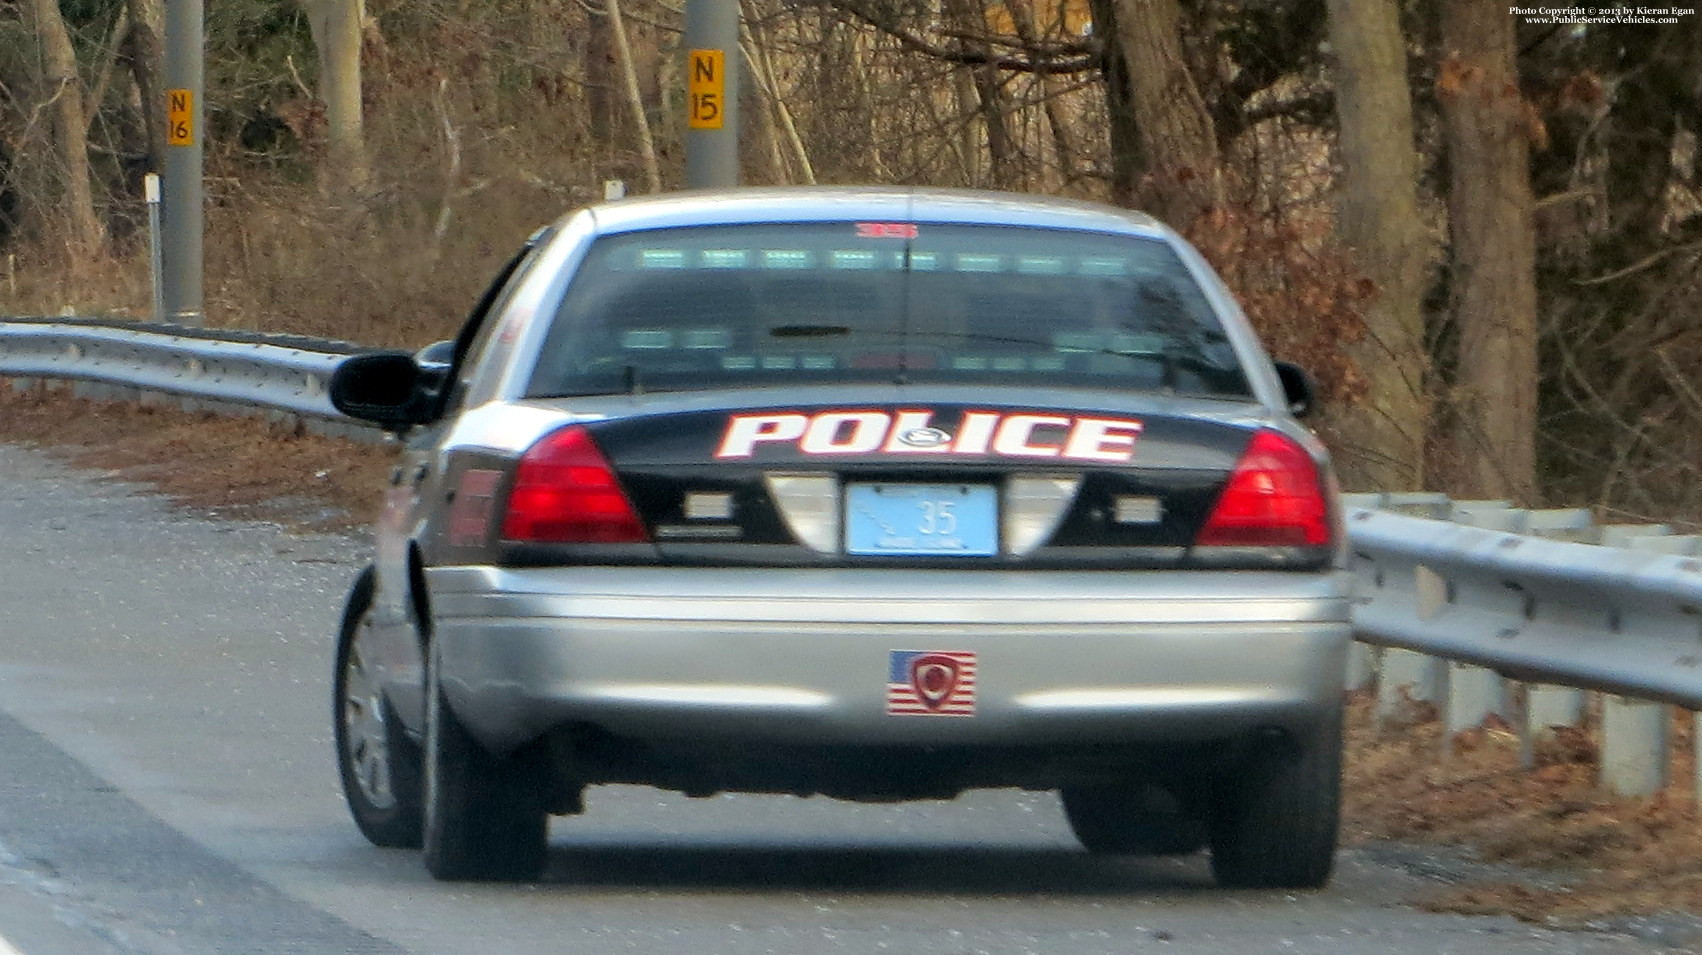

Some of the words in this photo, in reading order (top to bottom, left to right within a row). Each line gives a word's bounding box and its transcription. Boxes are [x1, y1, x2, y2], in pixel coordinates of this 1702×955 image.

[695, 56, 714, 82] N
[172, 94, 185, 112] N
[692, 93, 718, 120] 15
[170, 121, 188, 138] 16
[714, 409, 1142, 462] POLICE
[917, 500, 957, 535] 35
